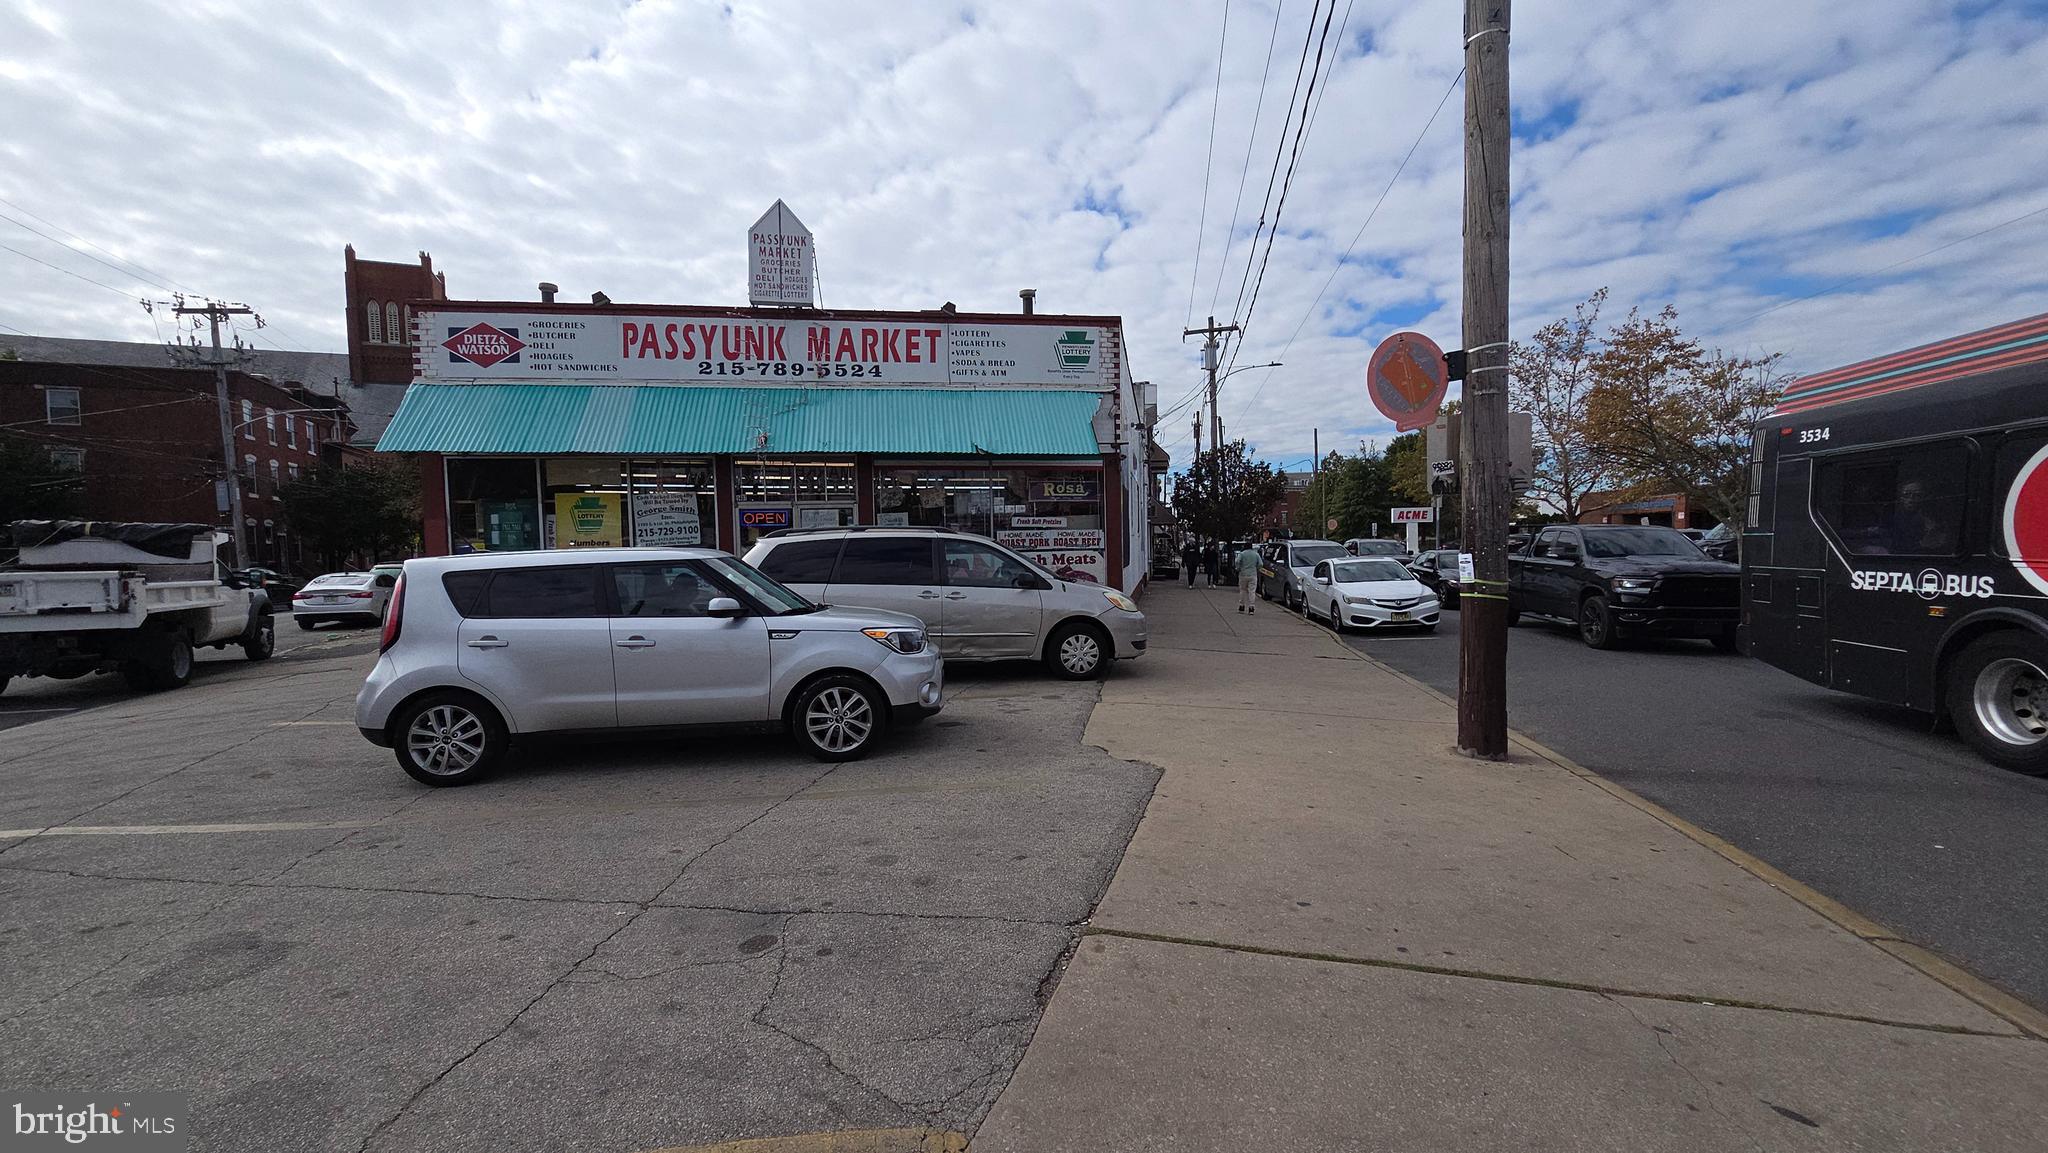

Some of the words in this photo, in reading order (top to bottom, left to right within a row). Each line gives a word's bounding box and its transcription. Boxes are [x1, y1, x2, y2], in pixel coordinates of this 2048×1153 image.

[754, 234, 806, 246] PASSYUNK
[759, 246, 802, 259] MARKET
[760, 259, 800, 267] GROCERIES
[762, 267, 800, 275] BUTCHER
[622, 322, 787, 361] PASSYUNK
[807, 327, 942, 363] MARKET
[457, 345, 510, 355] WATSON
[699, 362, 882, 378] 215-789-5524
[1800, 427, 1830, 443] 3534
[1044, 483, 1088, 496] Rosa
[637, 506, 667, 516] George
[669, 505, 696, 515] Smith
[1398, 511, 1428, 520] ACME
[744, 513, 785, 523] OPEN
[638, 526, 699, 537] 215-729-9100
[1001, 539, 1026, 547] ROAST
[1029, 538, 1049, 547] PORK
[1054, 538, 1079, 546] ROAST
[1080, 538, 1101, 546] BEEF
[1052, 554, 1096, 565] Meats
[1851, 570, 1914, 593] SEPTA
[1944, 574, 1994, 598] BUS
